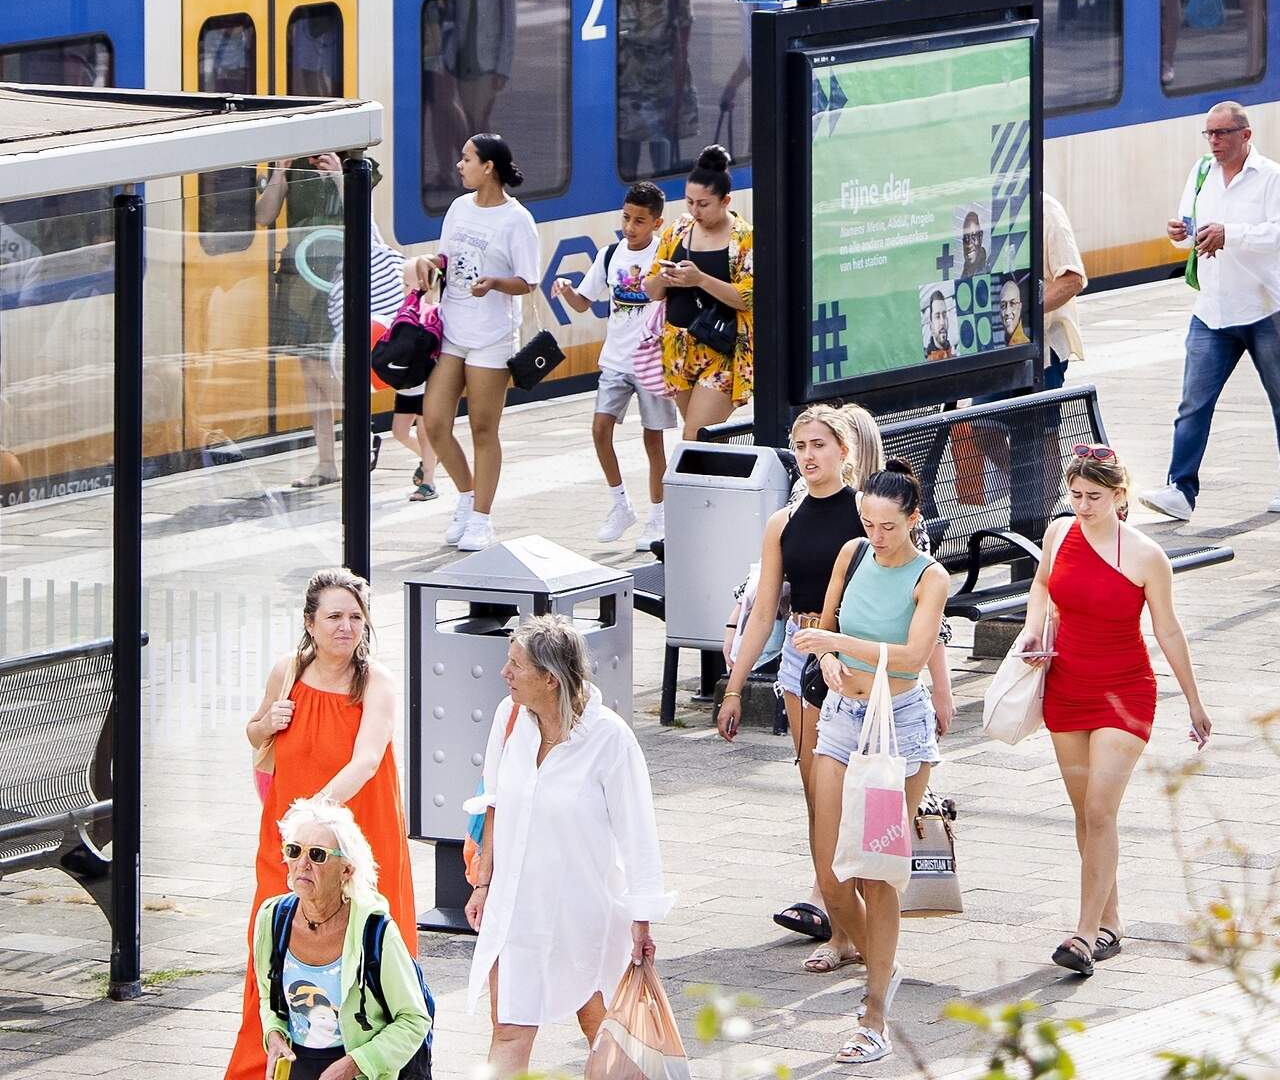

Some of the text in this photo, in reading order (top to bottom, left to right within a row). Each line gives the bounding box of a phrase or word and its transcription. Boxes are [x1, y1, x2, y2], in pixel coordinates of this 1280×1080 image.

[840, 172, 911, 215] Fijne dag
[865, 253, 888, 268] station
[915, 859, 946, 871] CHRISTIAN
